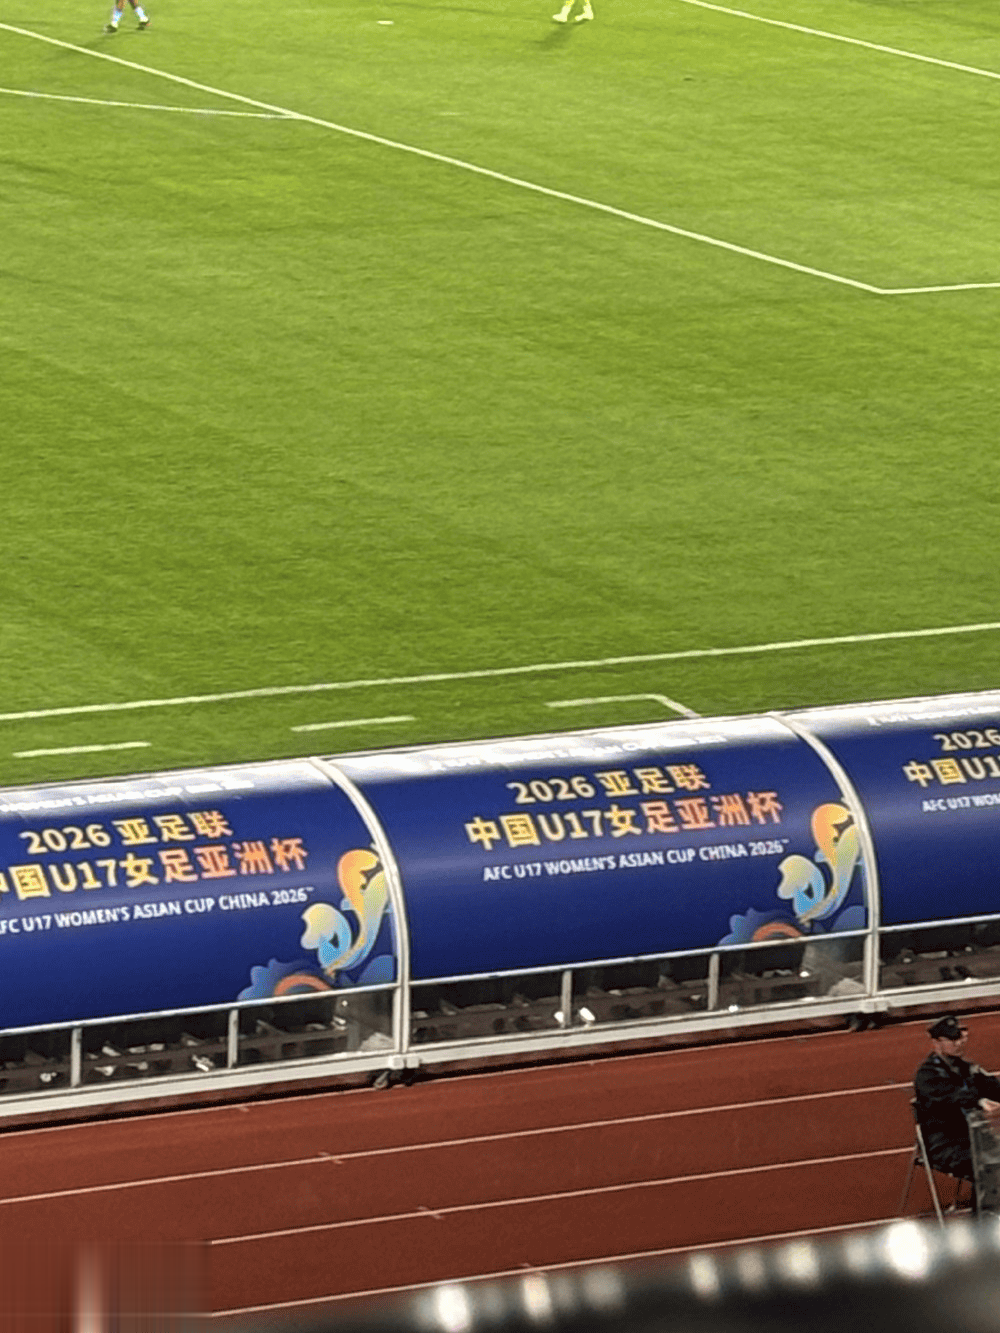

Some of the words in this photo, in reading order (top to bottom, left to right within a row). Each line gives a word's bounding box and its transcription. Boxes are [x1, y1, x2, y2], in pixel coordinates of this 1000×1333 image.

[932, 729, 1000, 752] 2026
[506, 776, 596, 804] 2026
[593, 764, 712, 798] 亚足联
[902, 755, 1000, 788] 中国U1
[19, 824, 111, 855] 2026
[111, 810, 234, 846] 亚足联
[464, 791, 783, 851] 中国U17女足亚洲杯
[483, 865, 513, 882] AFC
[513, 862, 543, 879] U17
[543, 855, 617, 876] WOMEN'S
[619, 850, 665, 870] ASIAN
[666, 848, 696, 865] CUP
[698, 842, 749, 862] CHINA
[22, 915, 52, 932] U17
[53, 906, 130, 928] WOMEN'S
[133, 901, 182, 920] ASIAN
[184, 897, 216, 914] CUP
[218, 891, 271, 911] CHINA
